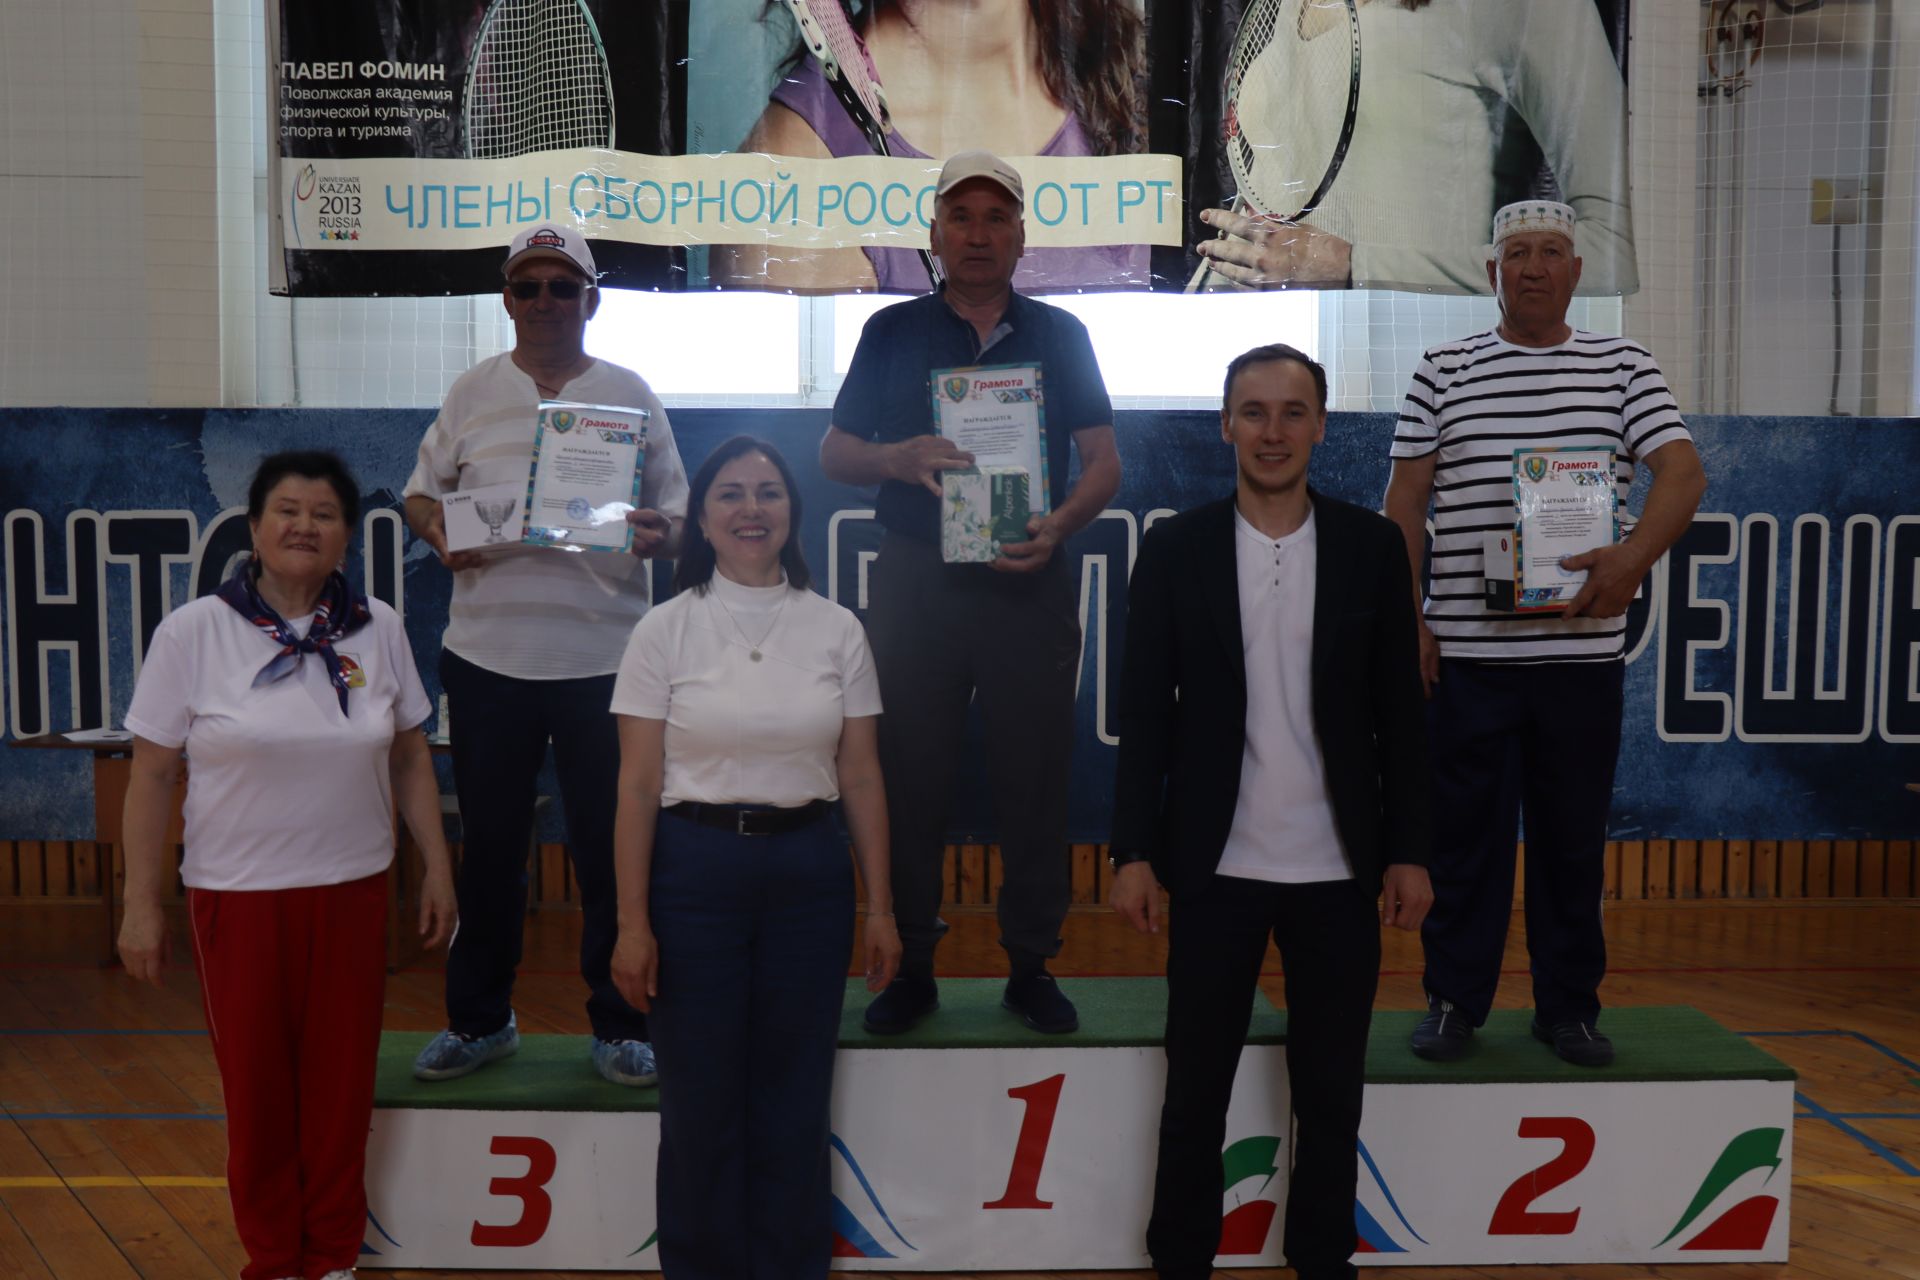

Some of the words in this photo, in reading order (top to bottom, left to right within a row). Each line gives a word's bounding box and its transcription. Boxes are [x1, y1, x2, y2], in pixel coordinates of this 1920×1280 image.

[280, 61, 354, 80] ПАВЕЛ
[359, 60, 445, 81] ФОМИН
[280, 85, 372, 100] Поволжская
[375, 87, 453, 101] академия
[280, 103, 370, 121] физической
[374, 106, 450, 122] культуры,
[280, 125, 333, 140] спорта
[337, 127, 346, 137] и
[351, 125, 412, 141] туризма
[319, 183, 361, 194] KAZAN
[319, 196, 361, 215] 2013
[385, 176, 551, 229] ЧЛЕНЫ
[569, 171, 799, 226] СБОРНОЙ
[817, 182, 938, 229] РОСС
[1033, 182, 1100, 226] ОТ
[1117, 180, 1173, 225] РТ
[319, 217, 361, 228] RUSSIA
[973, 378, 1025, 392] Грамота
[579, 416, 629, 431] Грамота
[1551, 459, 1599, 472] Грамота
[983, 1073, 1065, 1210] 1
[1487, 1116, 1596, 1235] 2
[470, 1135, 557, 1248] 3
